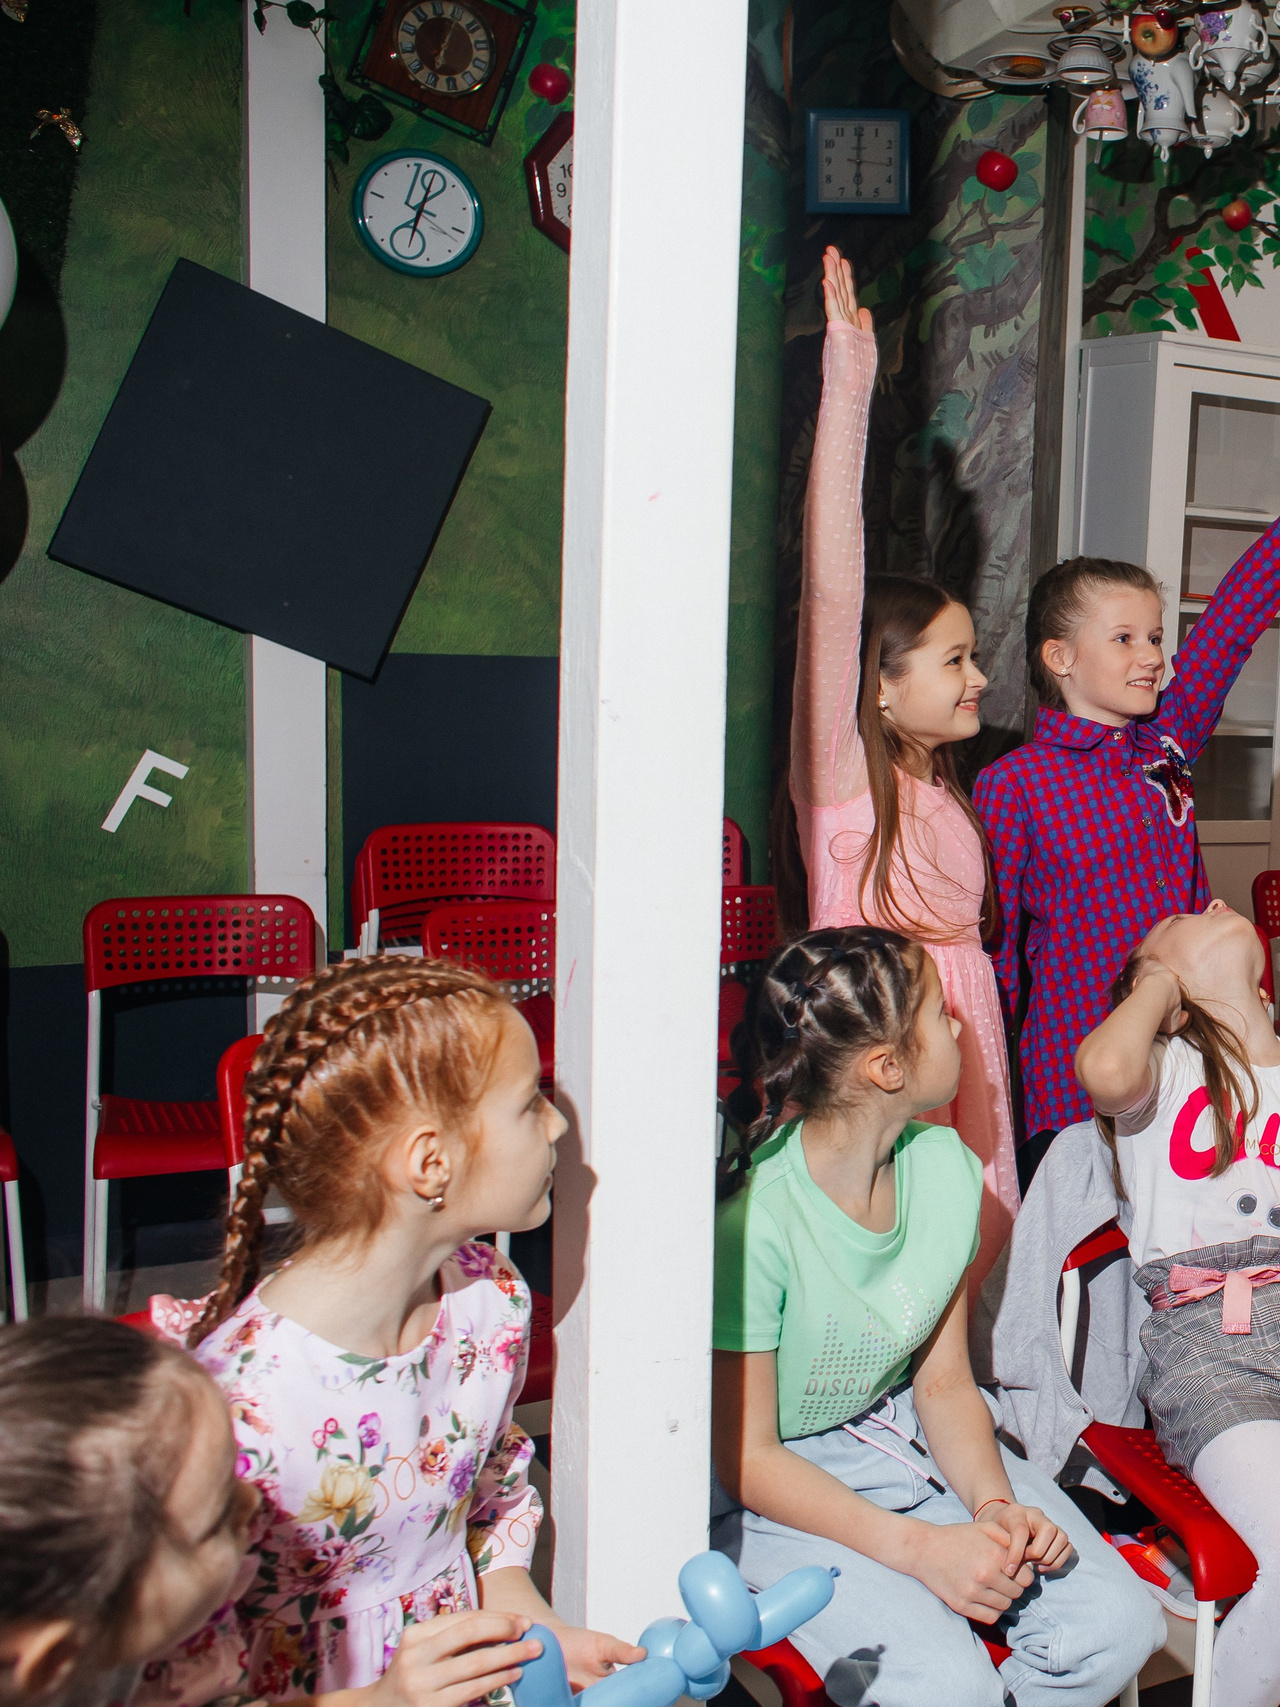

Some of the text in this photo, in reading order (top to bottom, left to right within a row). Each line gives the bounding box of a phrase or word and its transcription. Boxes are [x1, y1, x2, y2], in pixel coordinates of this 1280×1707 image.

[835, 127, 844, 137] 11
[874, 127, 879, 138] 1
[824, 139, 835, 149] 10
[886, 140, 893, 150] 2
[825, 157, 832, 167] 9
[886, 157, 893, 167] 3
[825, 174, 832, 184] 8
[885, 175, 892, 184] 4
[556, 182, 567, 198] 9
[838, 187, 845, 197] 7
[855, 187, 862, 197] 6
[873, 187, 880, 197] 5
[101, 749, 189, 833] F
[804, 1376, 871, 1397] DISCO
